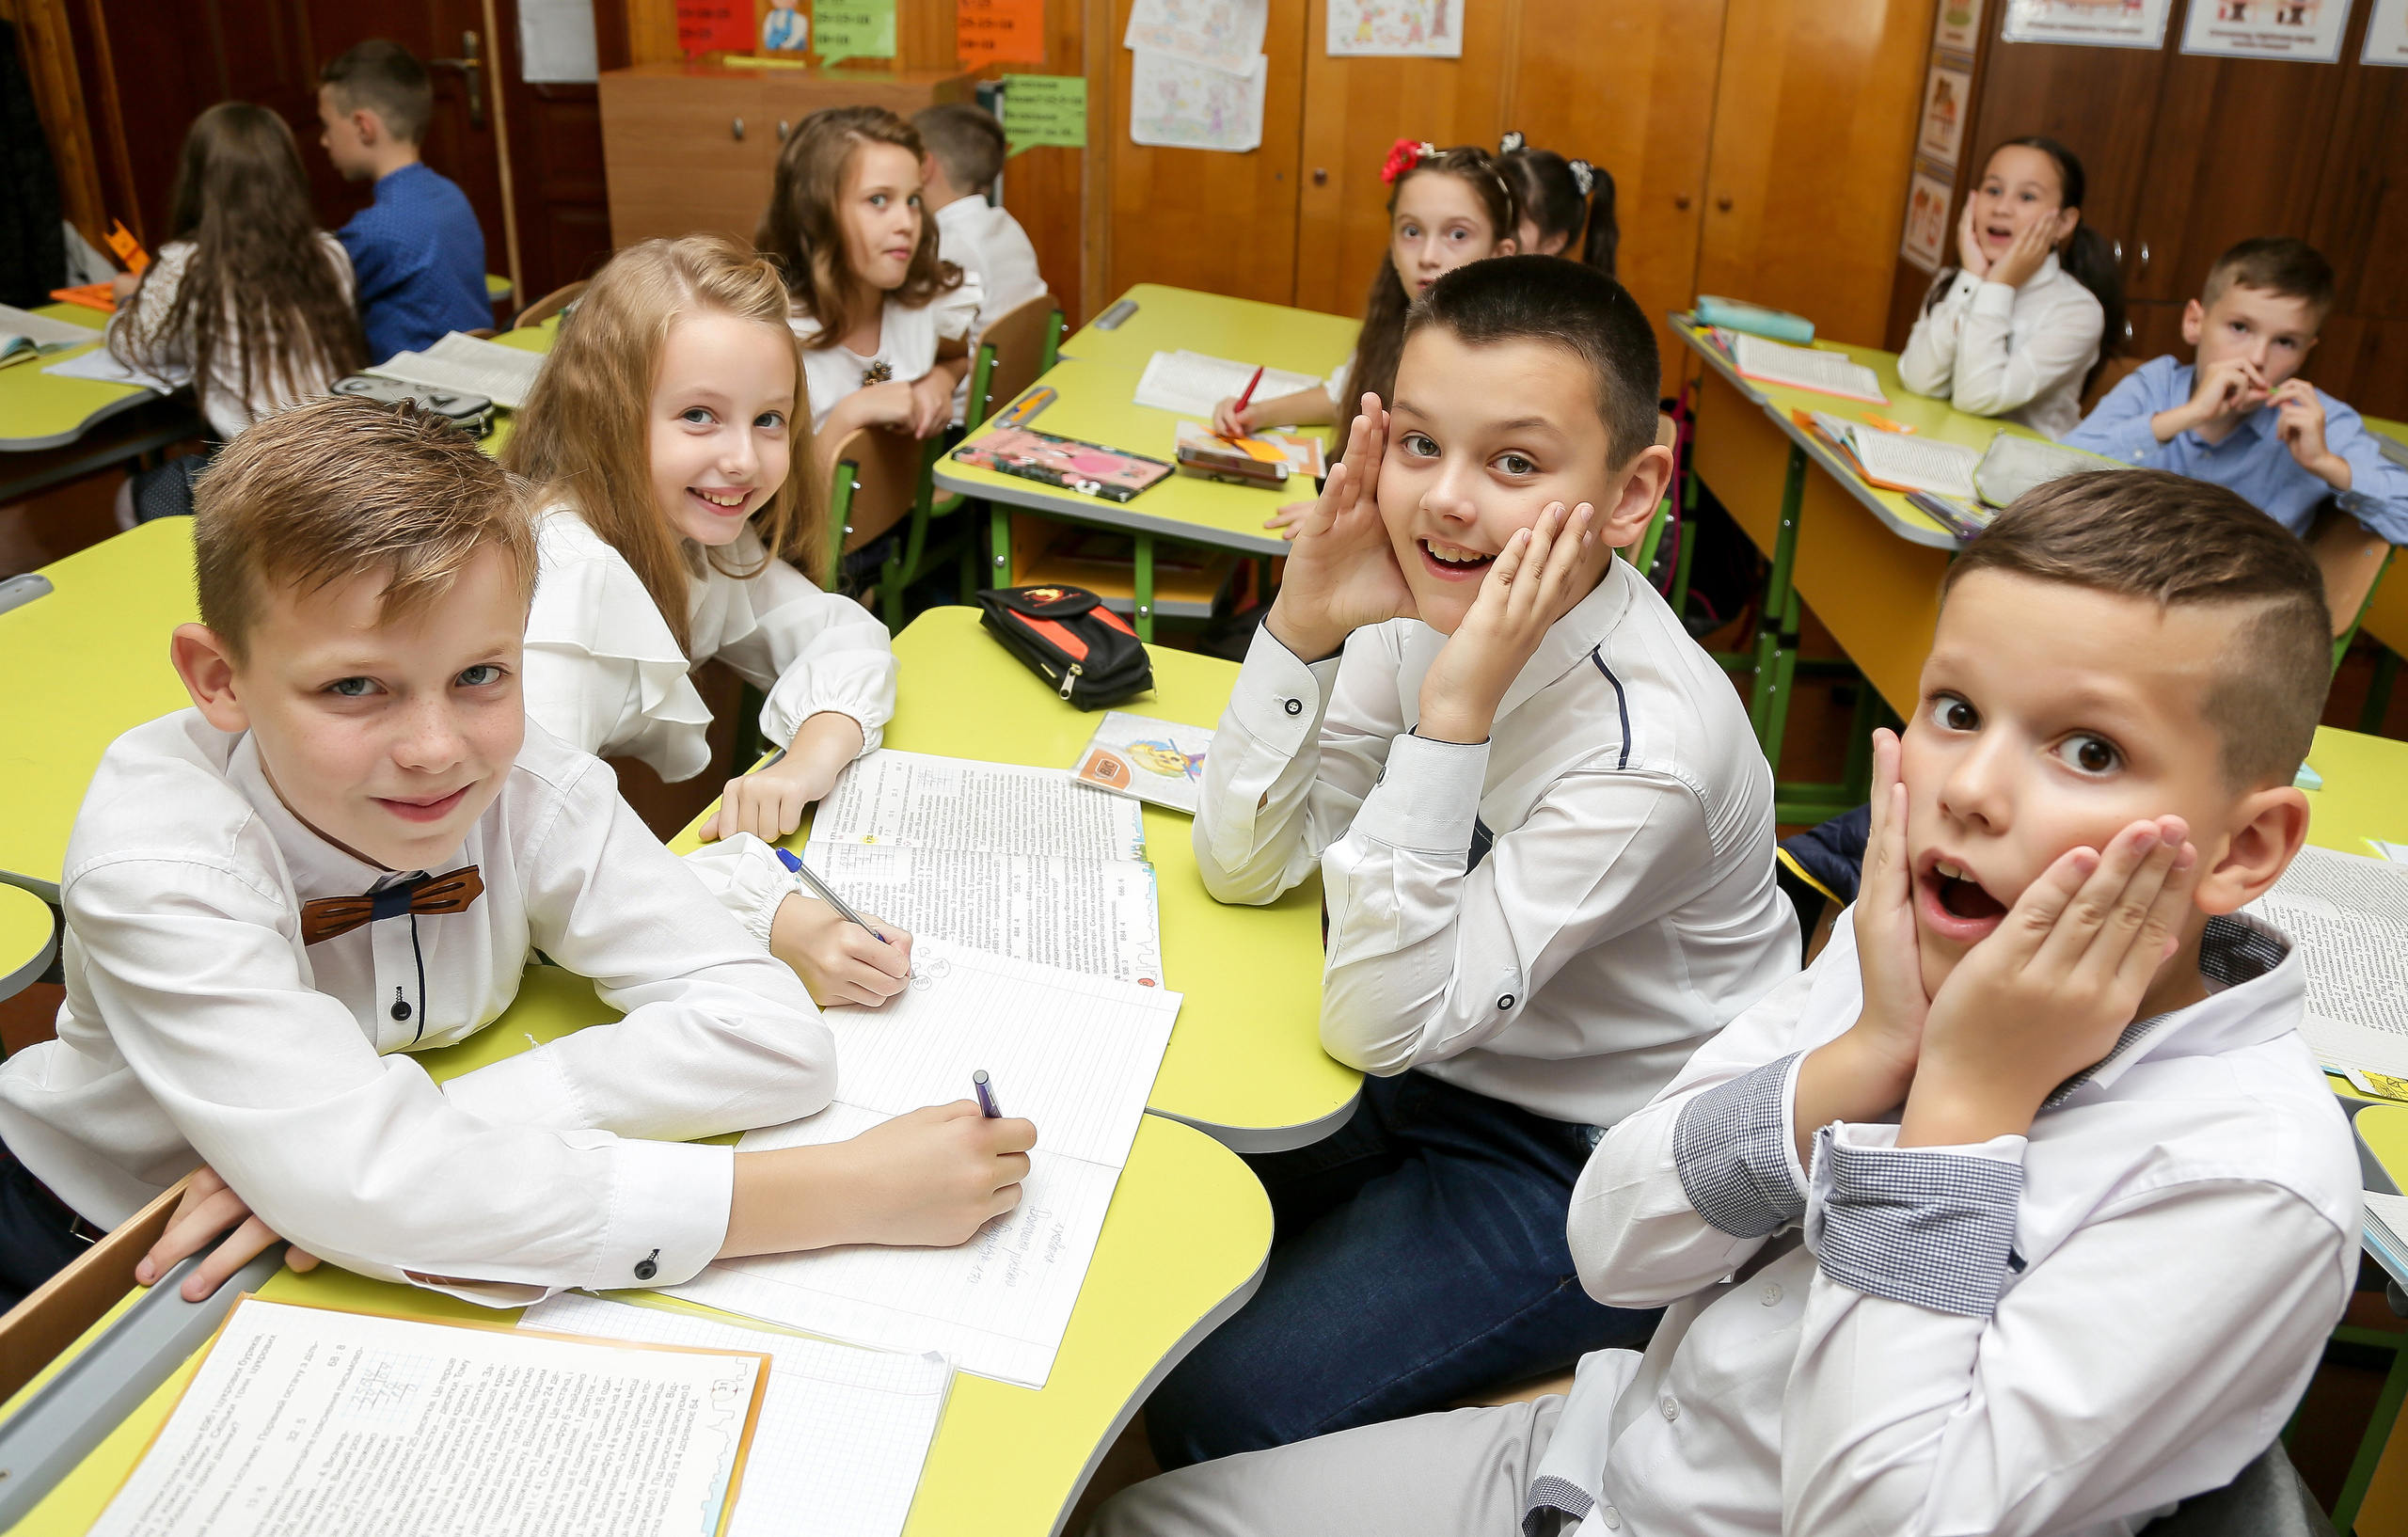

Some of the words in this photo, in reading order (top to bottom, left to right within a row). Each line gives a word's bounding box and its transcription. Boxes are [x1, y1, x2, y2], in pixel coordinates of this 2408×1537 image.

[1100, 760, 1115, 776] BIC
[281, 1369, 307, 1398] остачу
[300, 1340, 322, 1361] діль-
[310, 1391, 341, 1438] пояснення
[336, 1346, 365, 1390] письмово-
[410, 1398, 439, 1435] десятків.
[437, 1357, 459, 1385] перше
[438, 1378, 462, 1415] десятки.
[463, 1378, 490, 1417] десятків.
[474, 1387, 500, 1422] (першої
[493, 1364, 511, 1387] крап-
[449, 1381, 474, 1417] крапки).
[484, 1388, 513, 1430] поділили.
[493, 1414, 516, 1451] десятки.
[507, 1366, 537, 1413] Записуємо
[508, 1418, 528, 1443] тобто
[528, 1368, 550, 1402] першим
[520, 1398, 552, 1447] Віднімаємо
[533, 1419, 556, 1458] десяток.
[554, 1373, 575, 1406] остача,
[548, 1420, 571, 1450] цифру
[563, 1372, 589, 1413] знайдено
[560, 1424, 582, 1456] ділене.
[578, 1384, 598, 1418] десяток
[596, 1404, 618, 1441] одиниць
[610, 1409, 630, 1436] частці
[624, 1377, 642, 1399] місці
[614, 1429, 635, 1462] скільки
[628, 1393, 649, 1430] одиниць
[572, 1431, 595, 1468] одиниць
[625, 1430, 651, 1480] одержуємо
[646, 1380, 667, 1418] одиниць.
[639, 1436, 660, 1481] неповним
[651, 1399, 673, 1436] діленим.
[657, 1436, 676, 1470] рискою
[668, 1390, 690, 1436] записуємо
[674, 1410, 698, 1451] дорівнює
